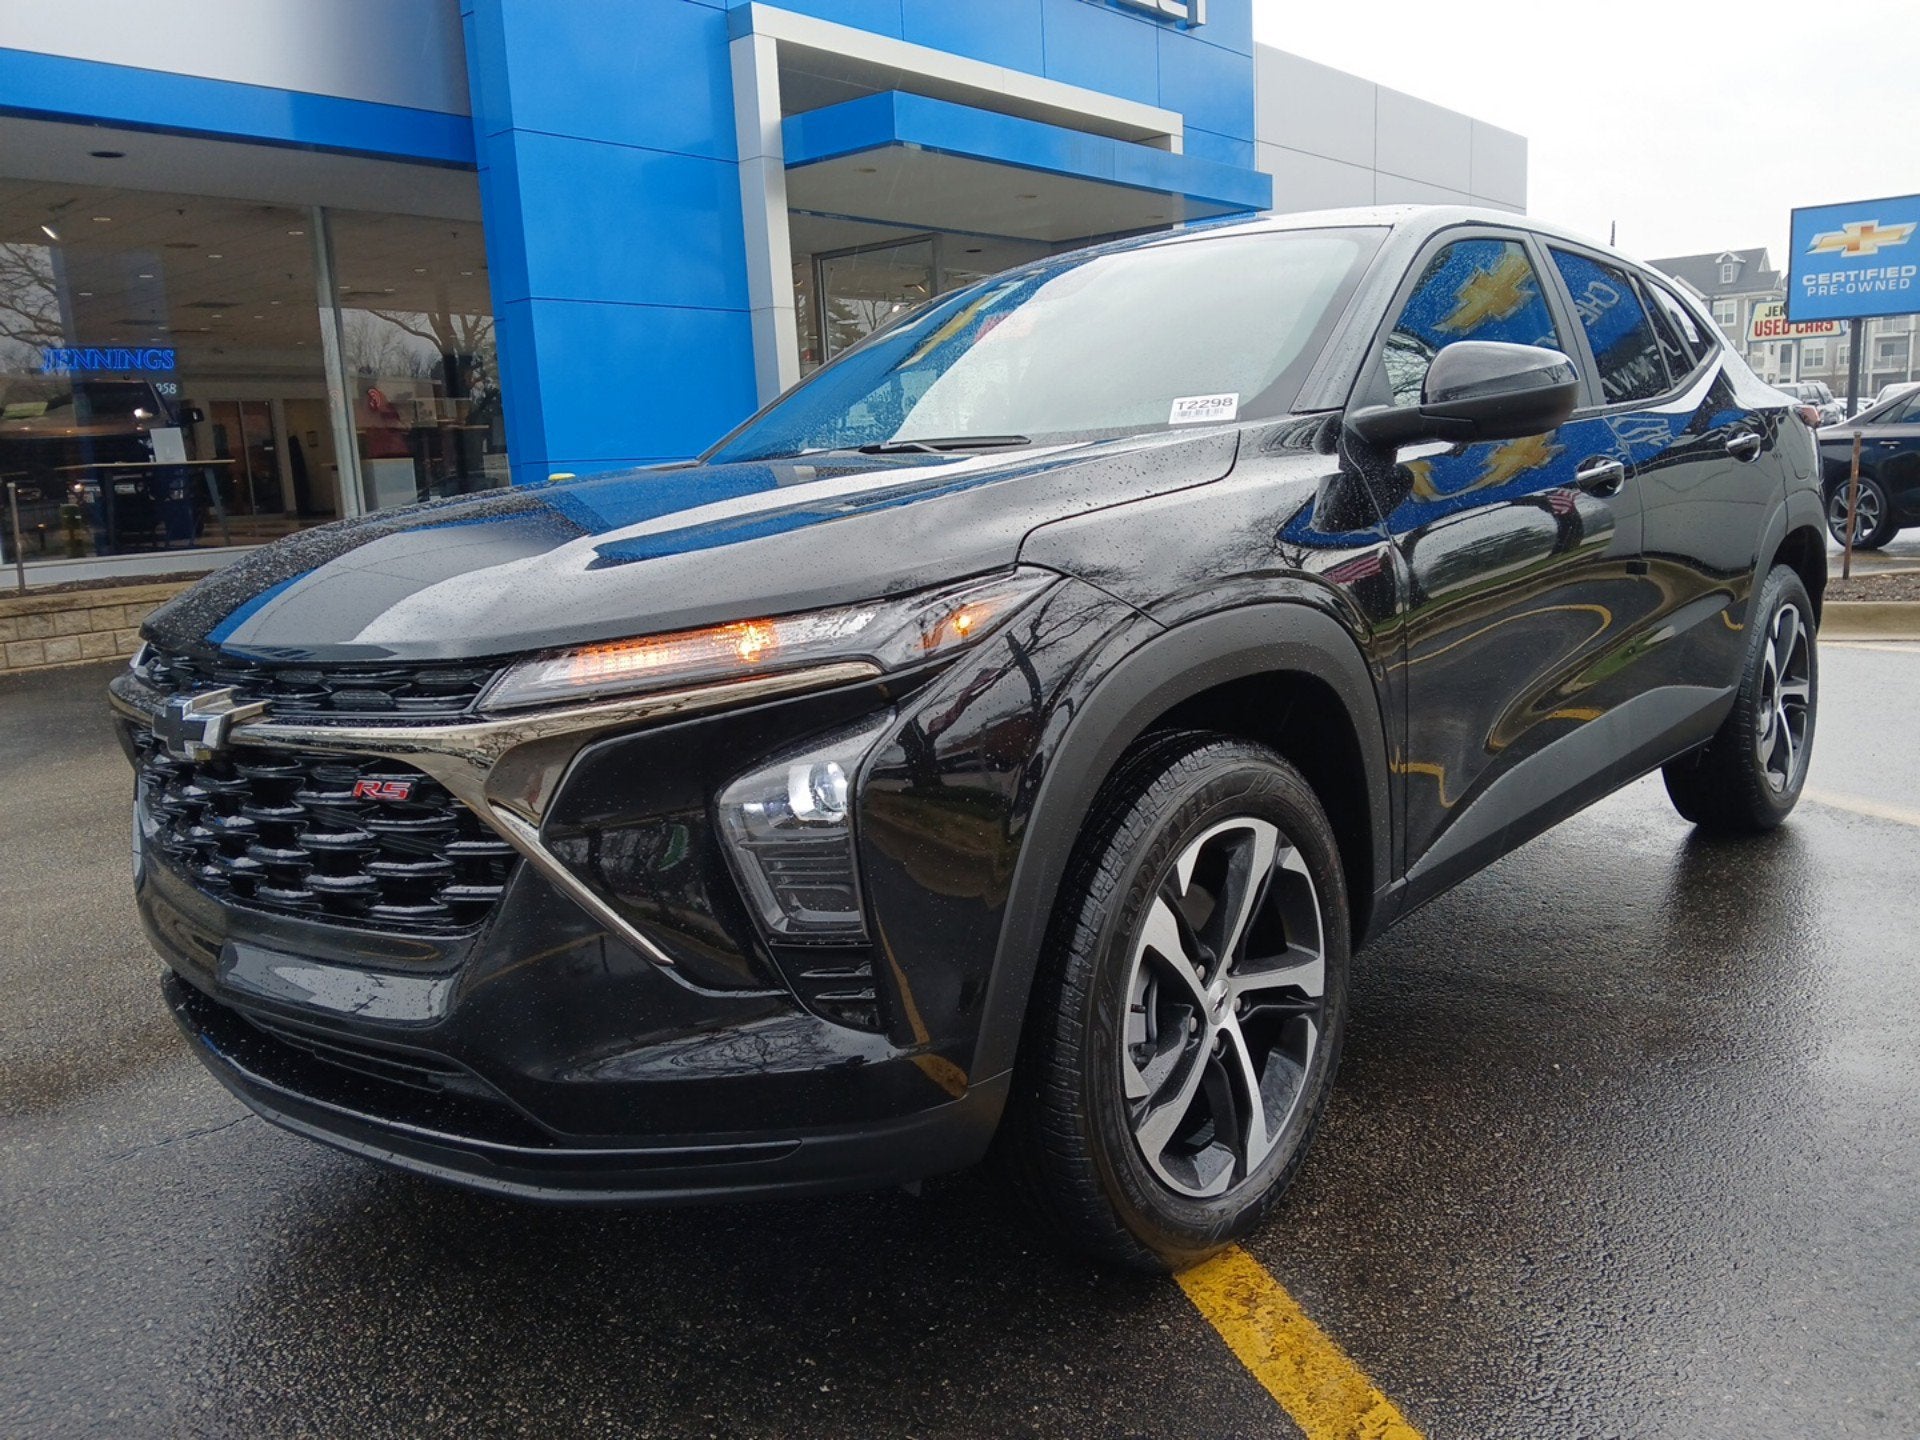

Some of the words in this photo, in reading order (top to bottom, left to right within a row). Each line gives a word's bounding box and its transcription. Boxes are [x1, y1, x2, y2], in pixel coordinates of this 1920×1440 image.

[1802, 265, 1917, 286] CERTIFIED
[1807, 278, 1911, 297] PRE-OWNED
[1754, 319, 1791, 337] USED
[1796, 321, 1834, 334] CARS
[41, 347, 175, 373] JENNINGS
[1176, 397, 1233, 410] T2298
[352, 780, 411, 800] RS
